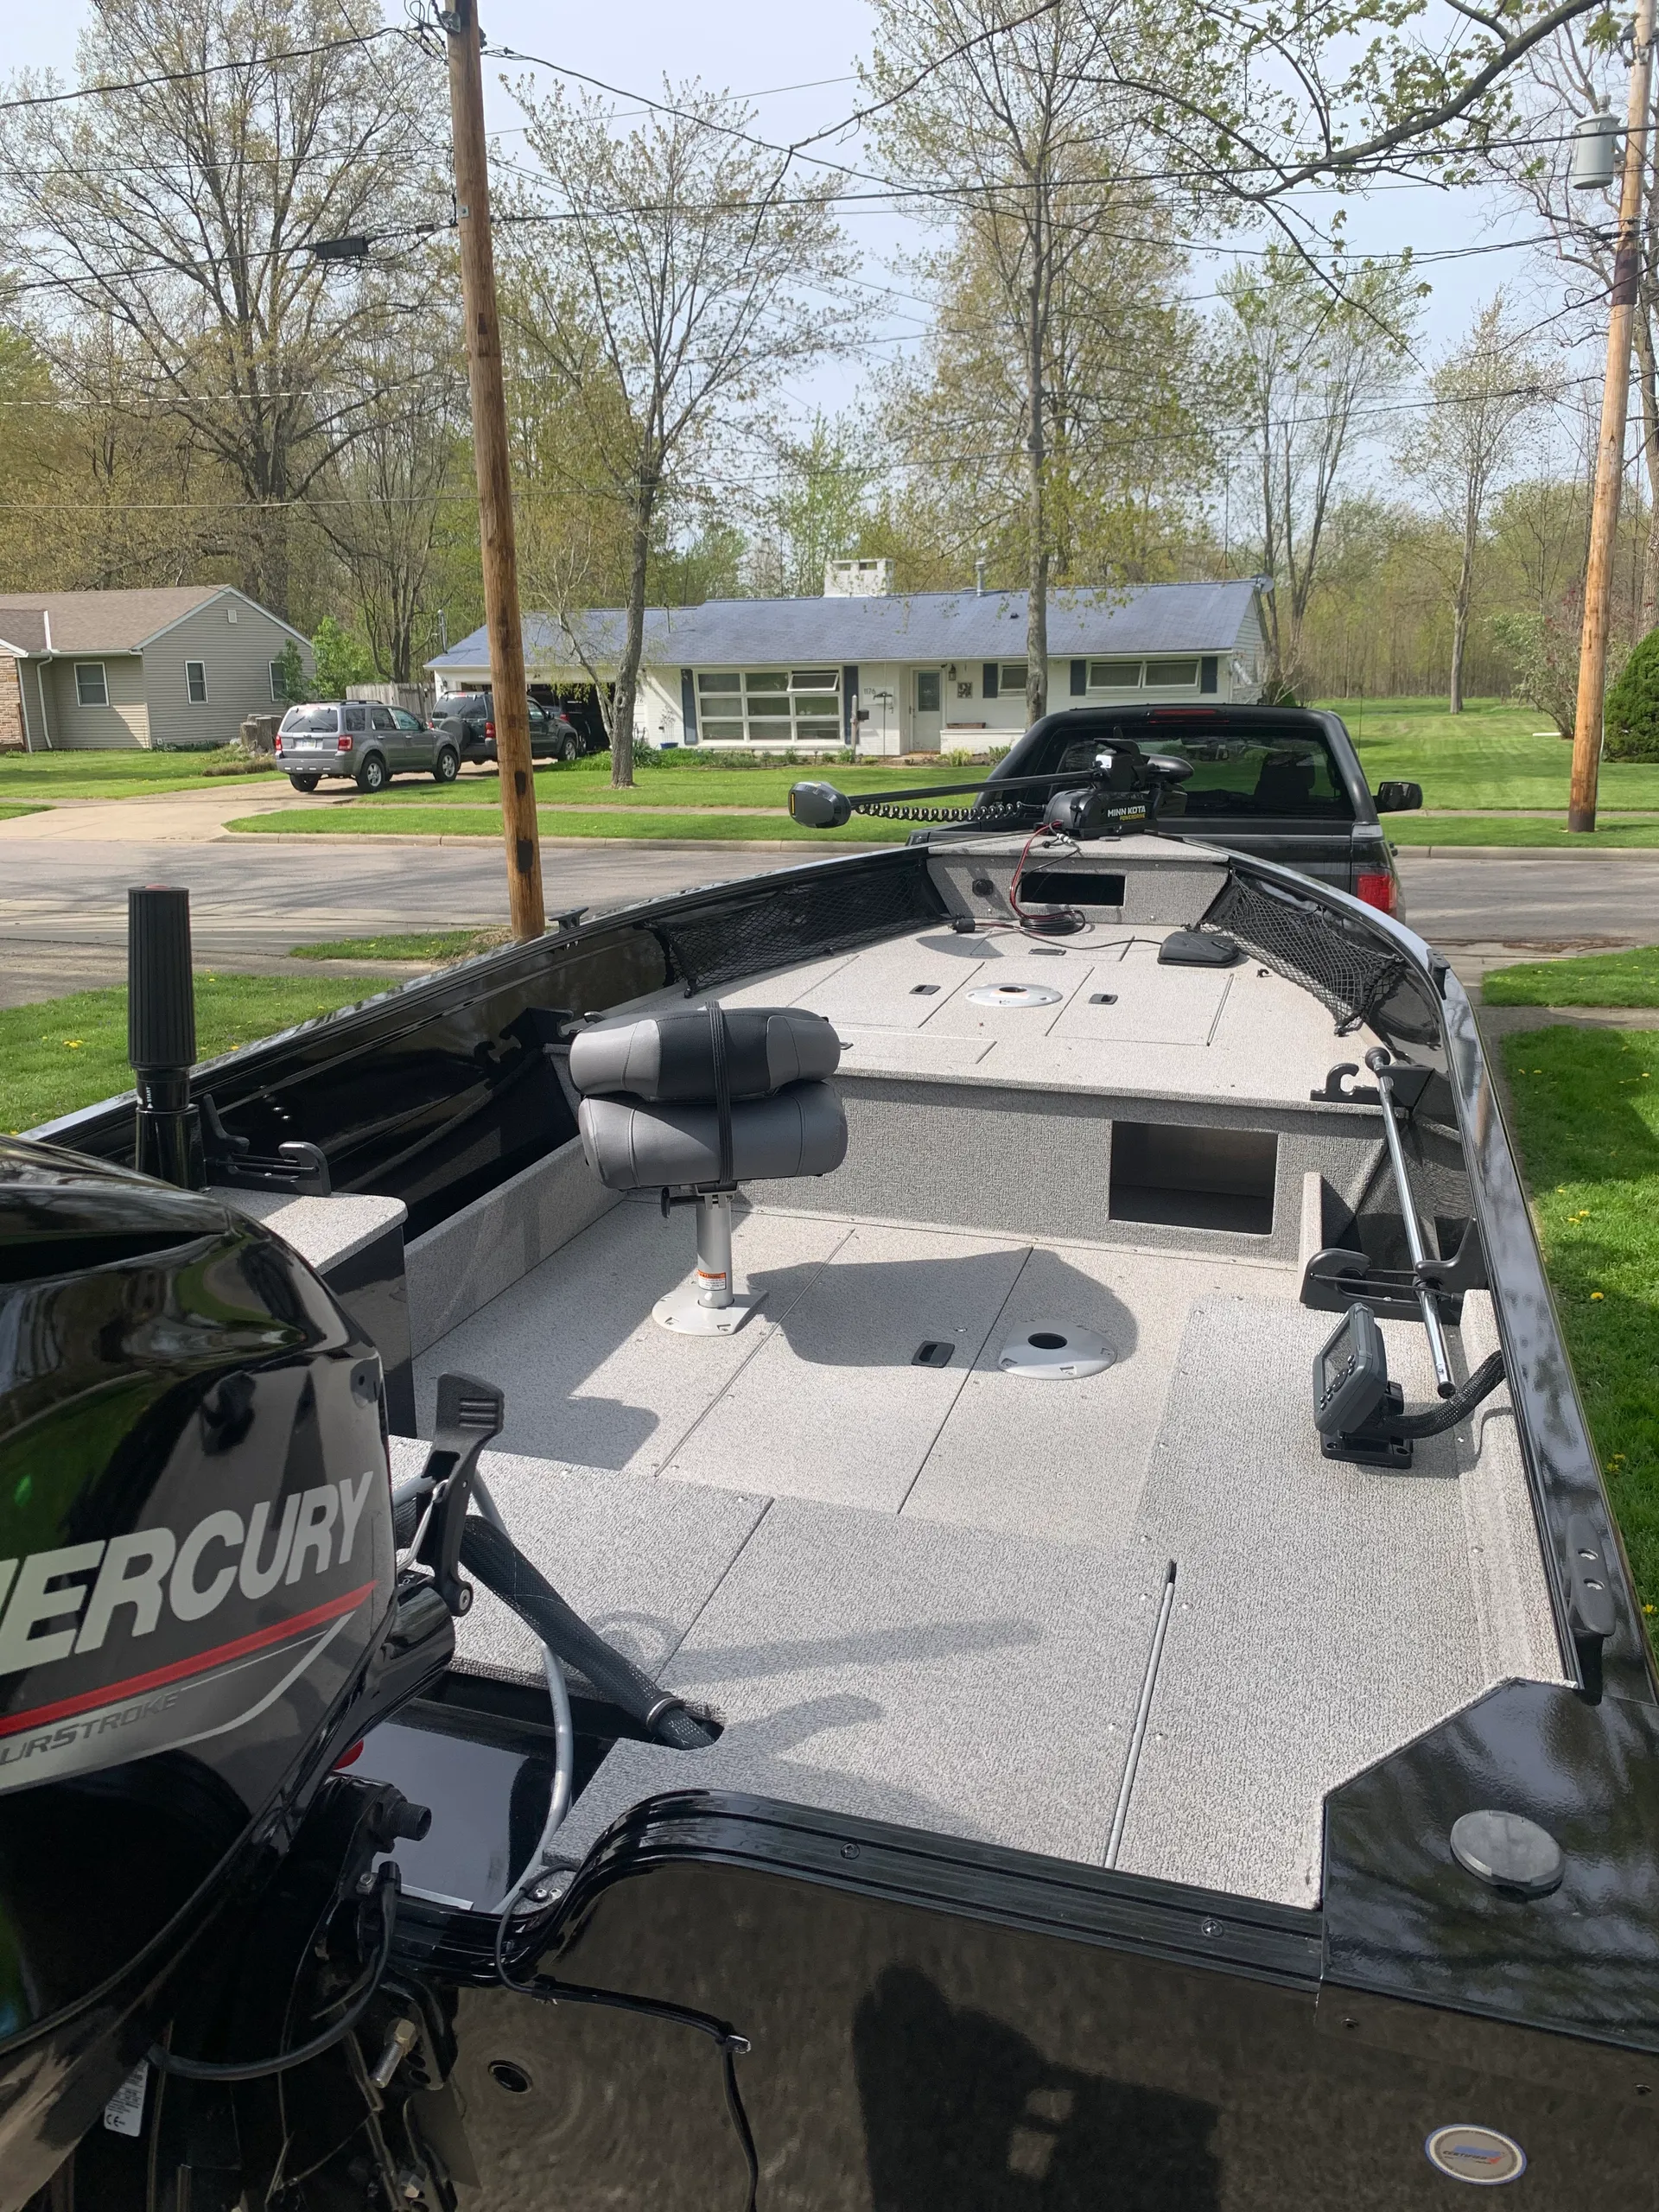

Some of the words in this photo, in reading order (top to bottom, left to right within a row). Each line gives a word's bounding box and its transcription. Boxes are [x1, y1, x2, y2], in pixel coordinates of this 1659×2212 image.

[1108, 807, 1127, 817] MINN
[1128, 805, 1146, 815] KOTA
[0, 1692, 181, 1765] URSTROKE
[1442, 2150, 1488, 2160] CERTIFIED
